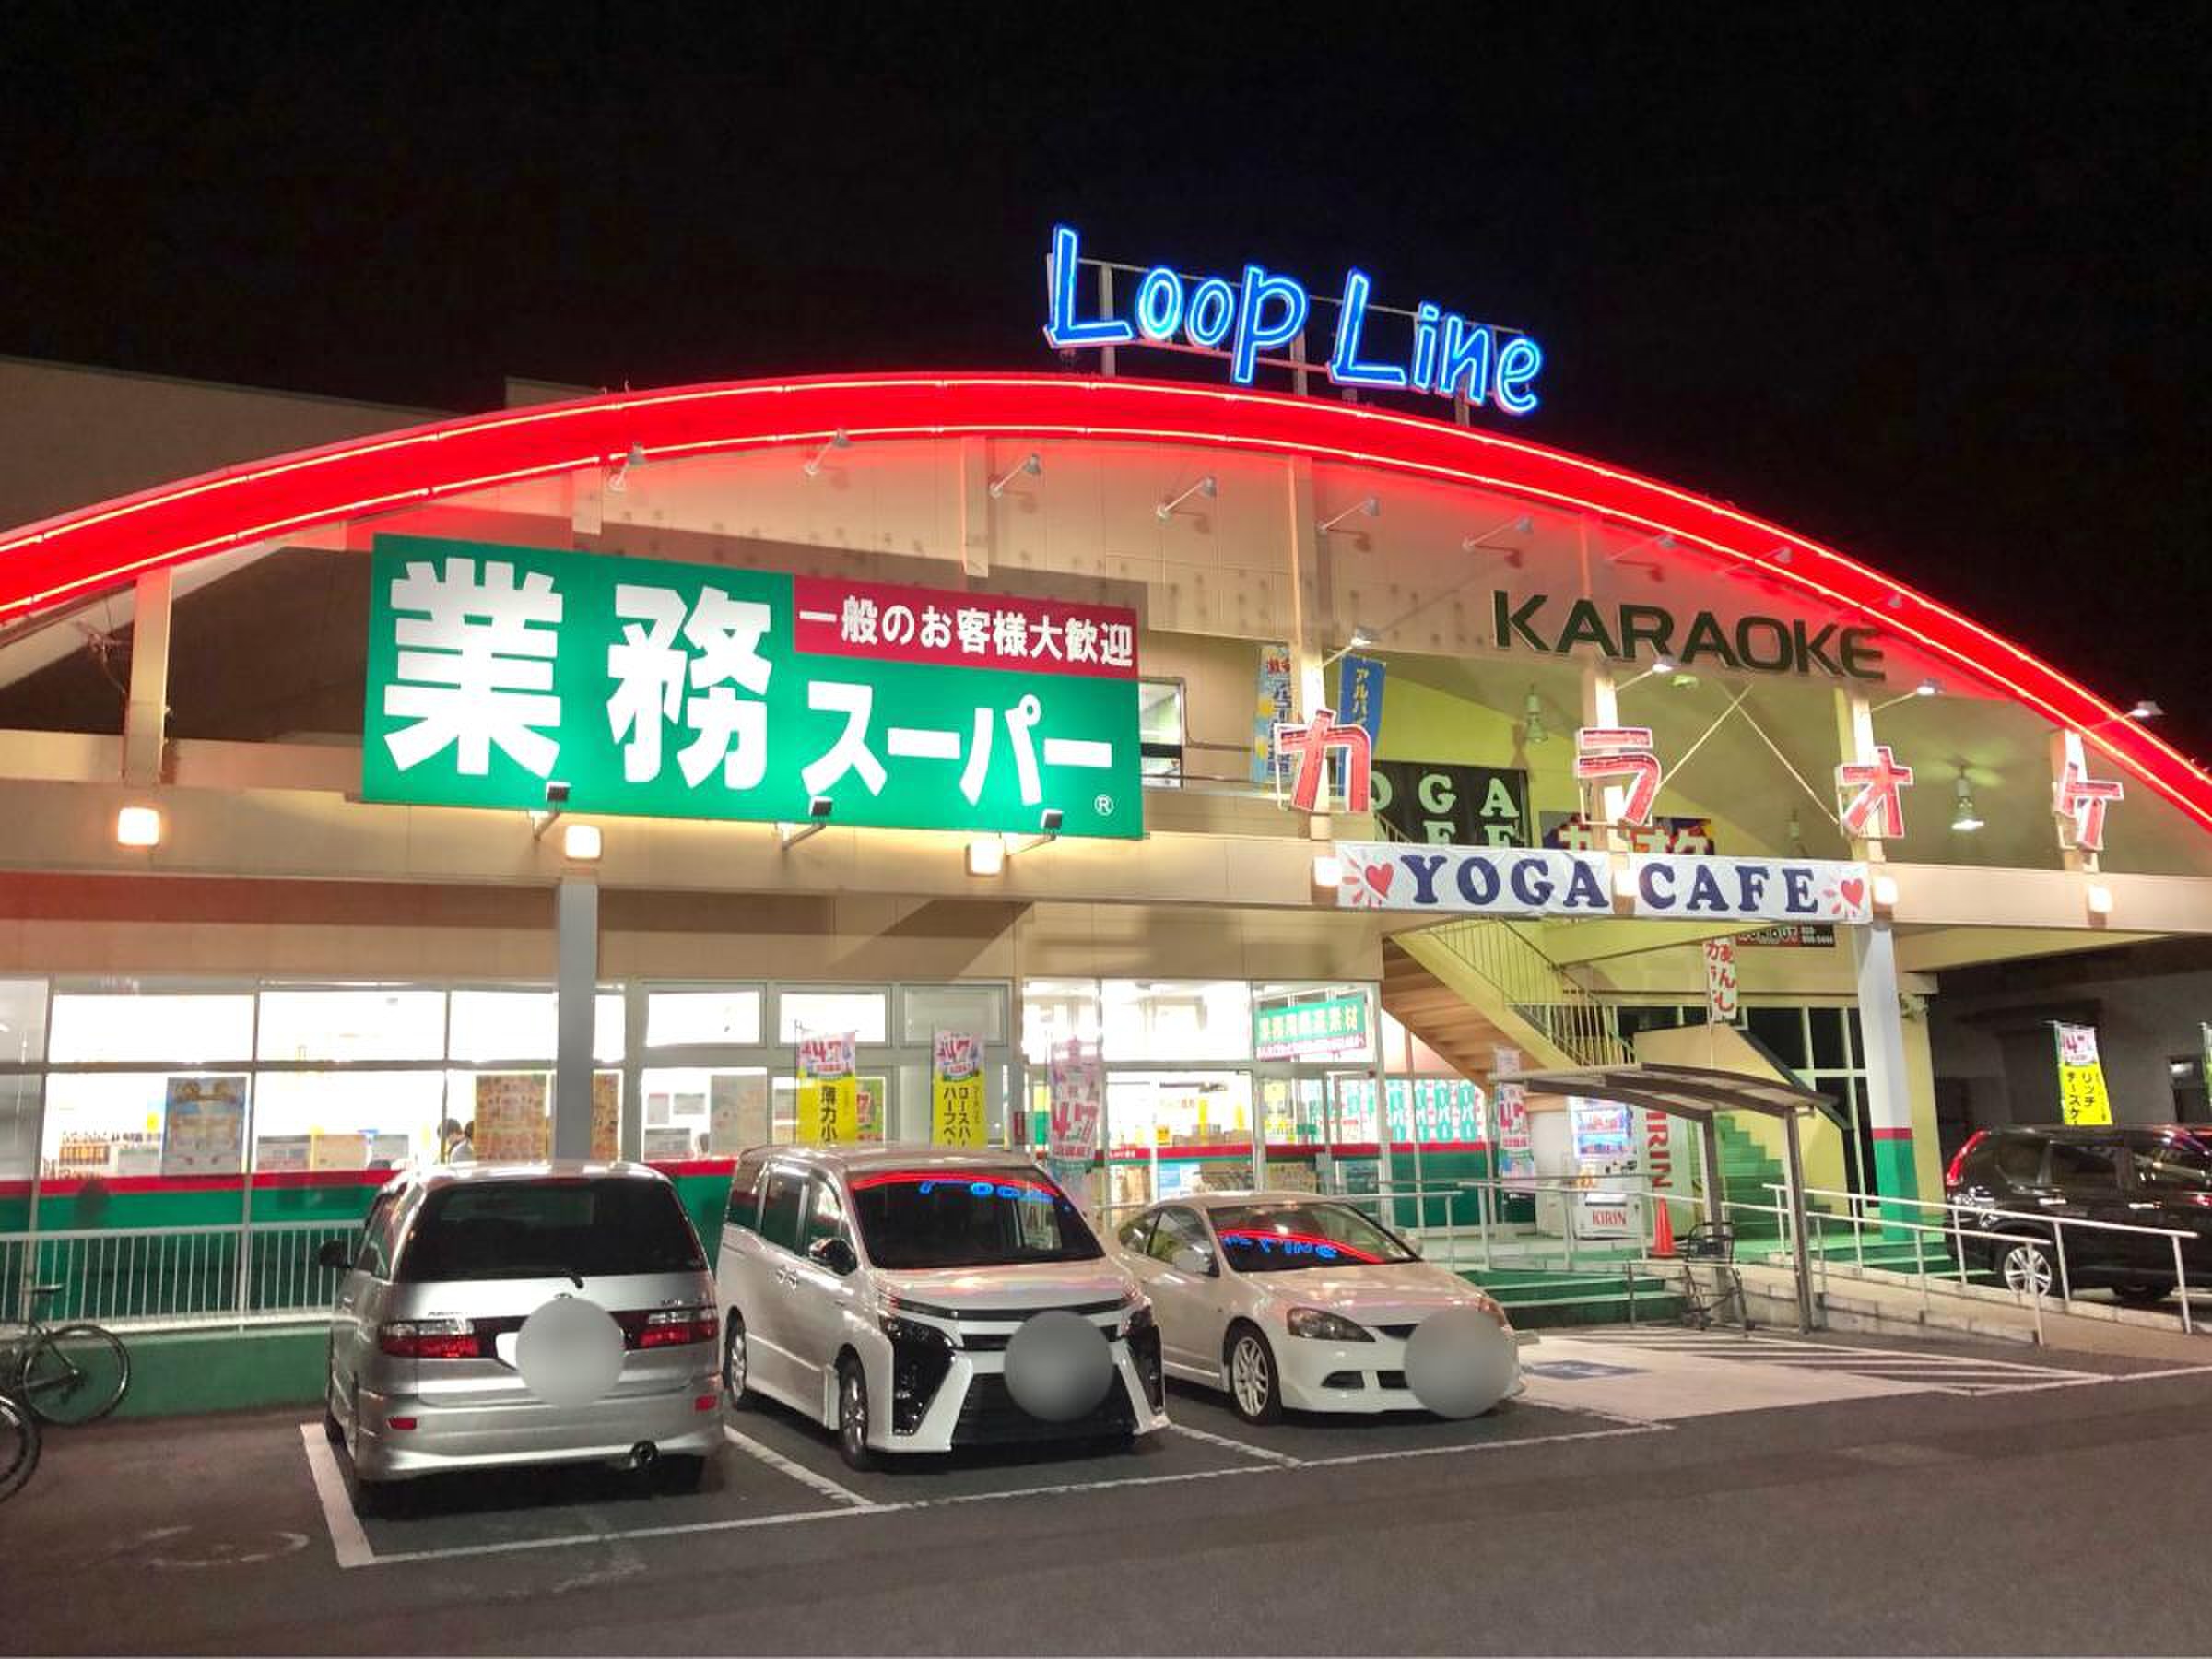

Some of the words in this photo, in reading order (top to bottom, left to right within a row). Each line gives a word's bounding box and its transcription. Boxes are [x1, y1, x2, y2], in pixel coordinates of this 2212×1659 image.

[1043, 224, 1308, 385] Loop
[1328, 269, 1543, 414] Line
[799, 595, 1135, 668] 一般のお客様大歓迎
[1492, 590, 1886, 682] KARAOKE
[383, 558, 1113, 808] 業務スーパー
[1400, 853, 1608, 908] YOGA
[1638, 862, 1819, 913] CAFE
[1645, 1111, 1673, 1188] IRIN
[1593, 1209, 1627, 1225] KIRIN
